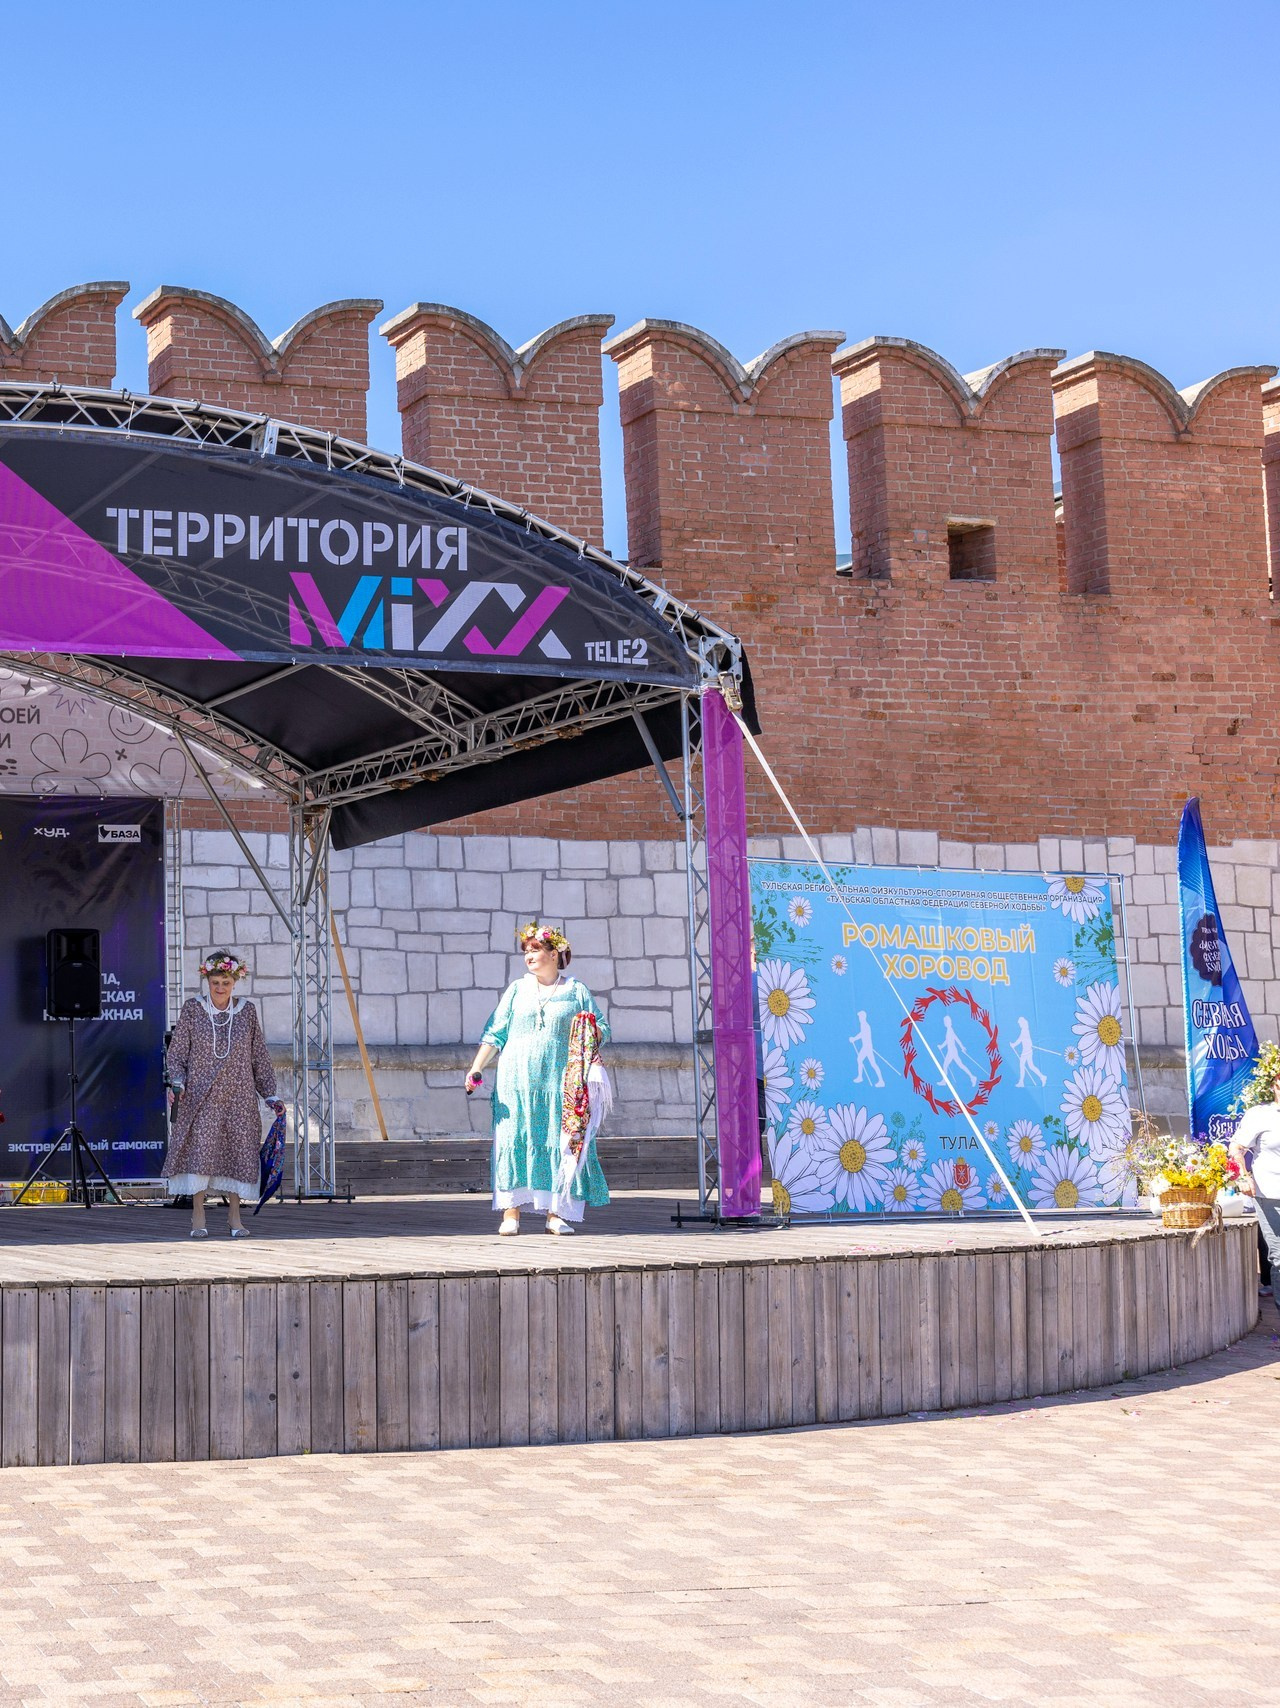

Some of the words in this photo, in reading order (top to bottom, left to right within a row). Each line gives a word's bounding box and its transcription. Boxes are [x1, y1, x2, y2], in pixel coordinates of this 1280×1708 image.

[105, 506, 468, 572] ТЕРРИТОРИЯ
[584, 639, 649, 666] TELE2
[111, 830, 140, 838] БАЗА
[761, 880, 803, 891] ТУЛЬСКАЯ
[987, 891, 1048, 902] ОБЩЕСТВЕННАЯ
[873, 897, 921, 906] ОБЛАСТНАЯ
[922, 899, 969, 909] ФЕДЕРАЦИЯ
[971, 901, 1010, 910] СЕВЕРНОЙ
[842, 922, 1036, 953] РОМАШКОВЫЙ
[883, 953, 1010, 986] ХОРОВОД
[111, 1140, 164, 1151] самокат
[939, 1136, 979, 1150] ТУЛА
